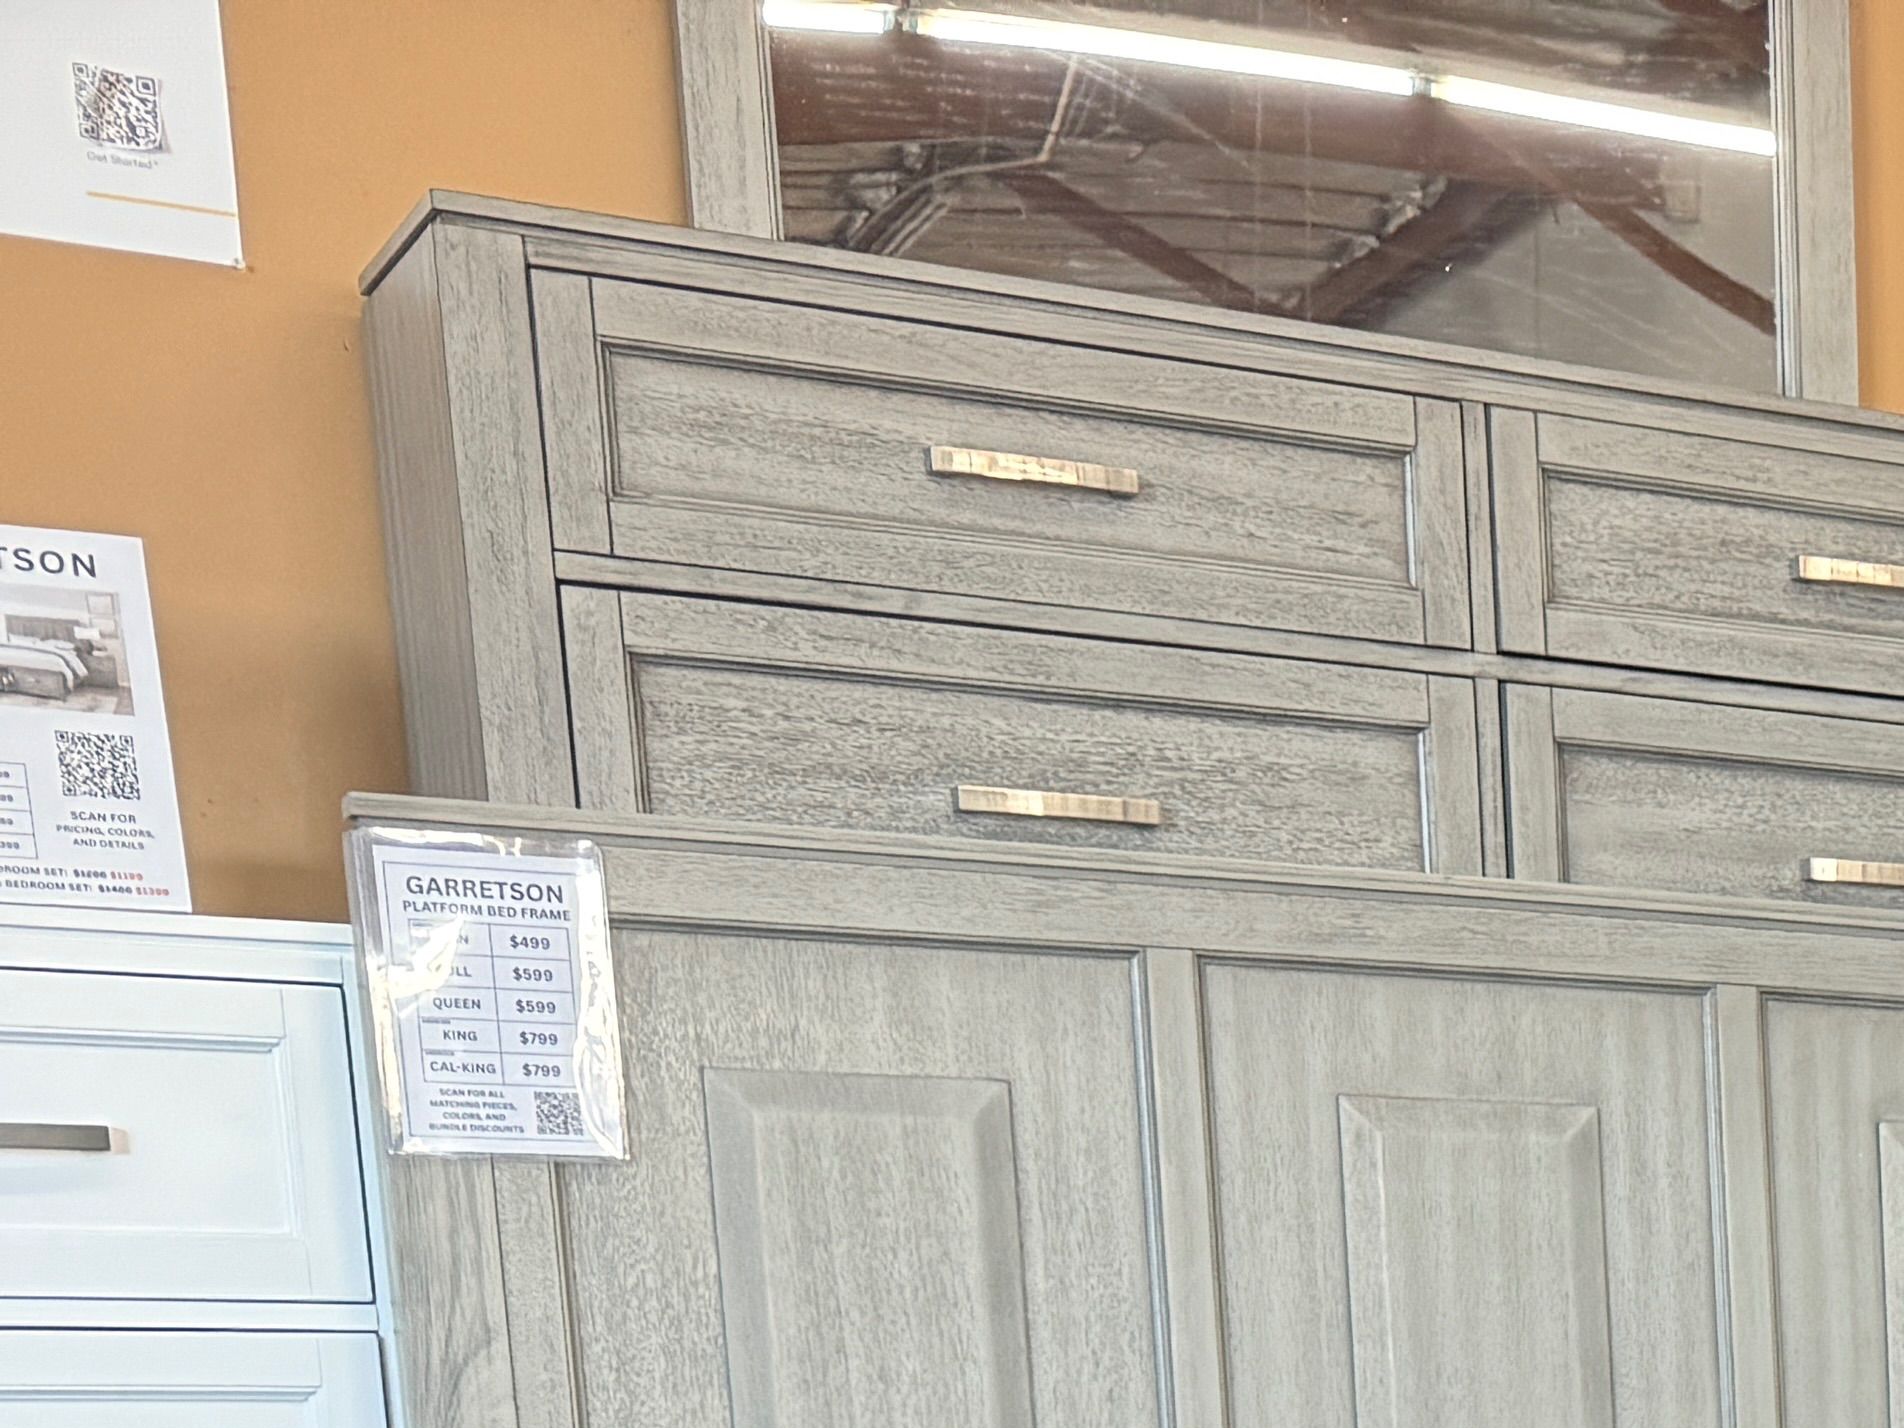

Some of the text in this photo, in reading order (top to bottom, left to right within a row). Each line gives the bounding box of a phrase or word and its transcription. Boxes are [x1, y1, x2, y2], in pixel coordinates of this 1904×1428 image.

[70, 811, 136, 824] SCAN FOR
[73, 838, 144, 850] AND DETAILS
[5, 880, 66, 889] BEDROOM
[406, 876, 563, 904] GARRETSON
[403, 900, 571, 921] PLATFORM BED FRAME
[510, 935, 550, 950] $499
[512, 966, 553, 982] $599
[433, 997, 556, 1014] QUEEN $599
[443, 1030, 558, 1046] KING $799
[430, 1061, 561, 1077] CAL-KING $799
[439, 1088, 465, 1097] SCAN
[491, 1090, 505, 1098] ALL
[486, 1113, 506, 1121] AND
[471, 1123, 524, 1133] DISCOUNTS
